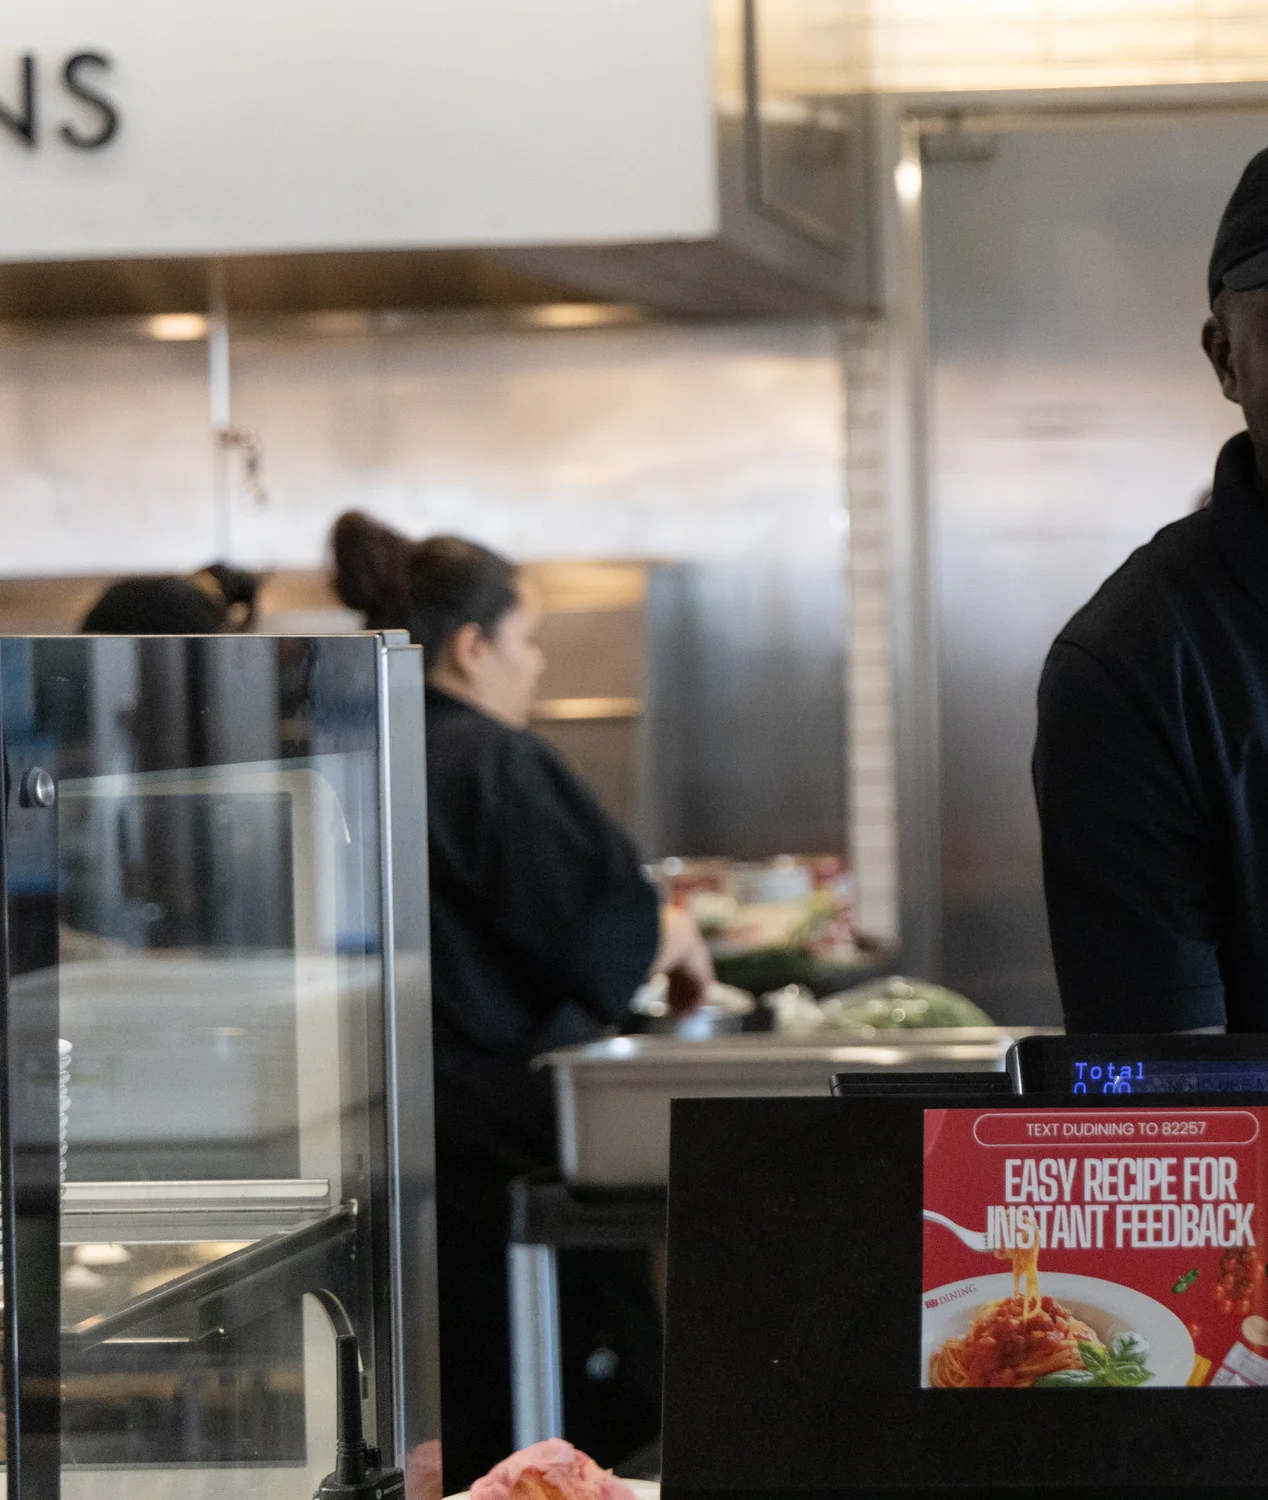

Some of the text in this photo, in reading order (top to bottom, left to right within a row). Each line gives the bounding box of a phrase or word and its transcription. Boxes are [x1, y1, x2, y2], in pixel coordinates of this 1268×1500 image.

[1075, 1062, 1144, 1080] Total
[1026, 1121, 1207, 1137] TEXT DUDINING TO 82257
[1005, 1156, 1239, 1202] EASY RECIPE FOR
[987, 1203, 1256, 1249] INSTANT FEEDBACK
[938, 1283, 978, 1305] DINING
